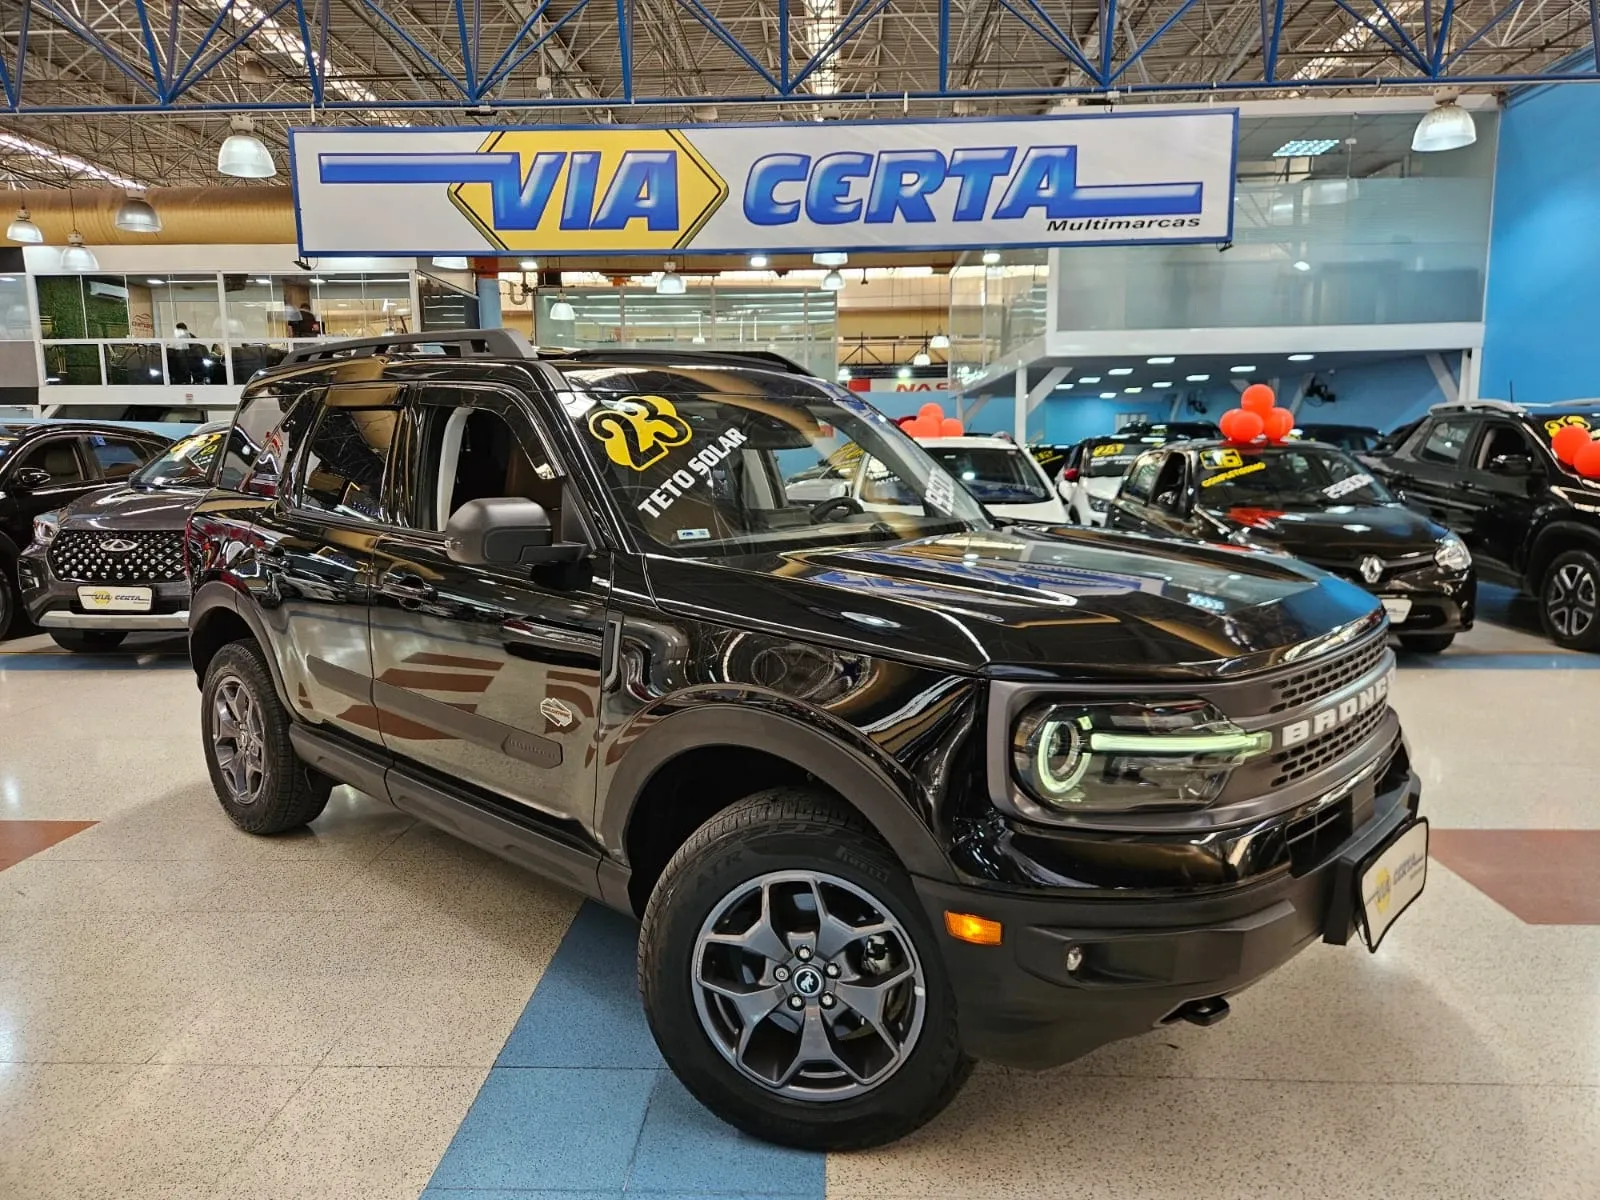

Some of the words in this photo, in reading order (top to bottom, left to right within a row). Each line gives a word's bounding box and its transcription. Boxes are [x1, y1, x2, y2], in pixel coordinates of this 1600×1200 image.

[493, 150, 680, 231] VIA
[743, 145, 1078, 226] CERTA
[1046, 217, 1201, 232] Multimarcas
[588, 396, 693, 472] 23
[637, 469, 696, 519] TETO
[688, 427, 748, 476] SOLAR
[1282, 666, 1397, 747] BRONCO
